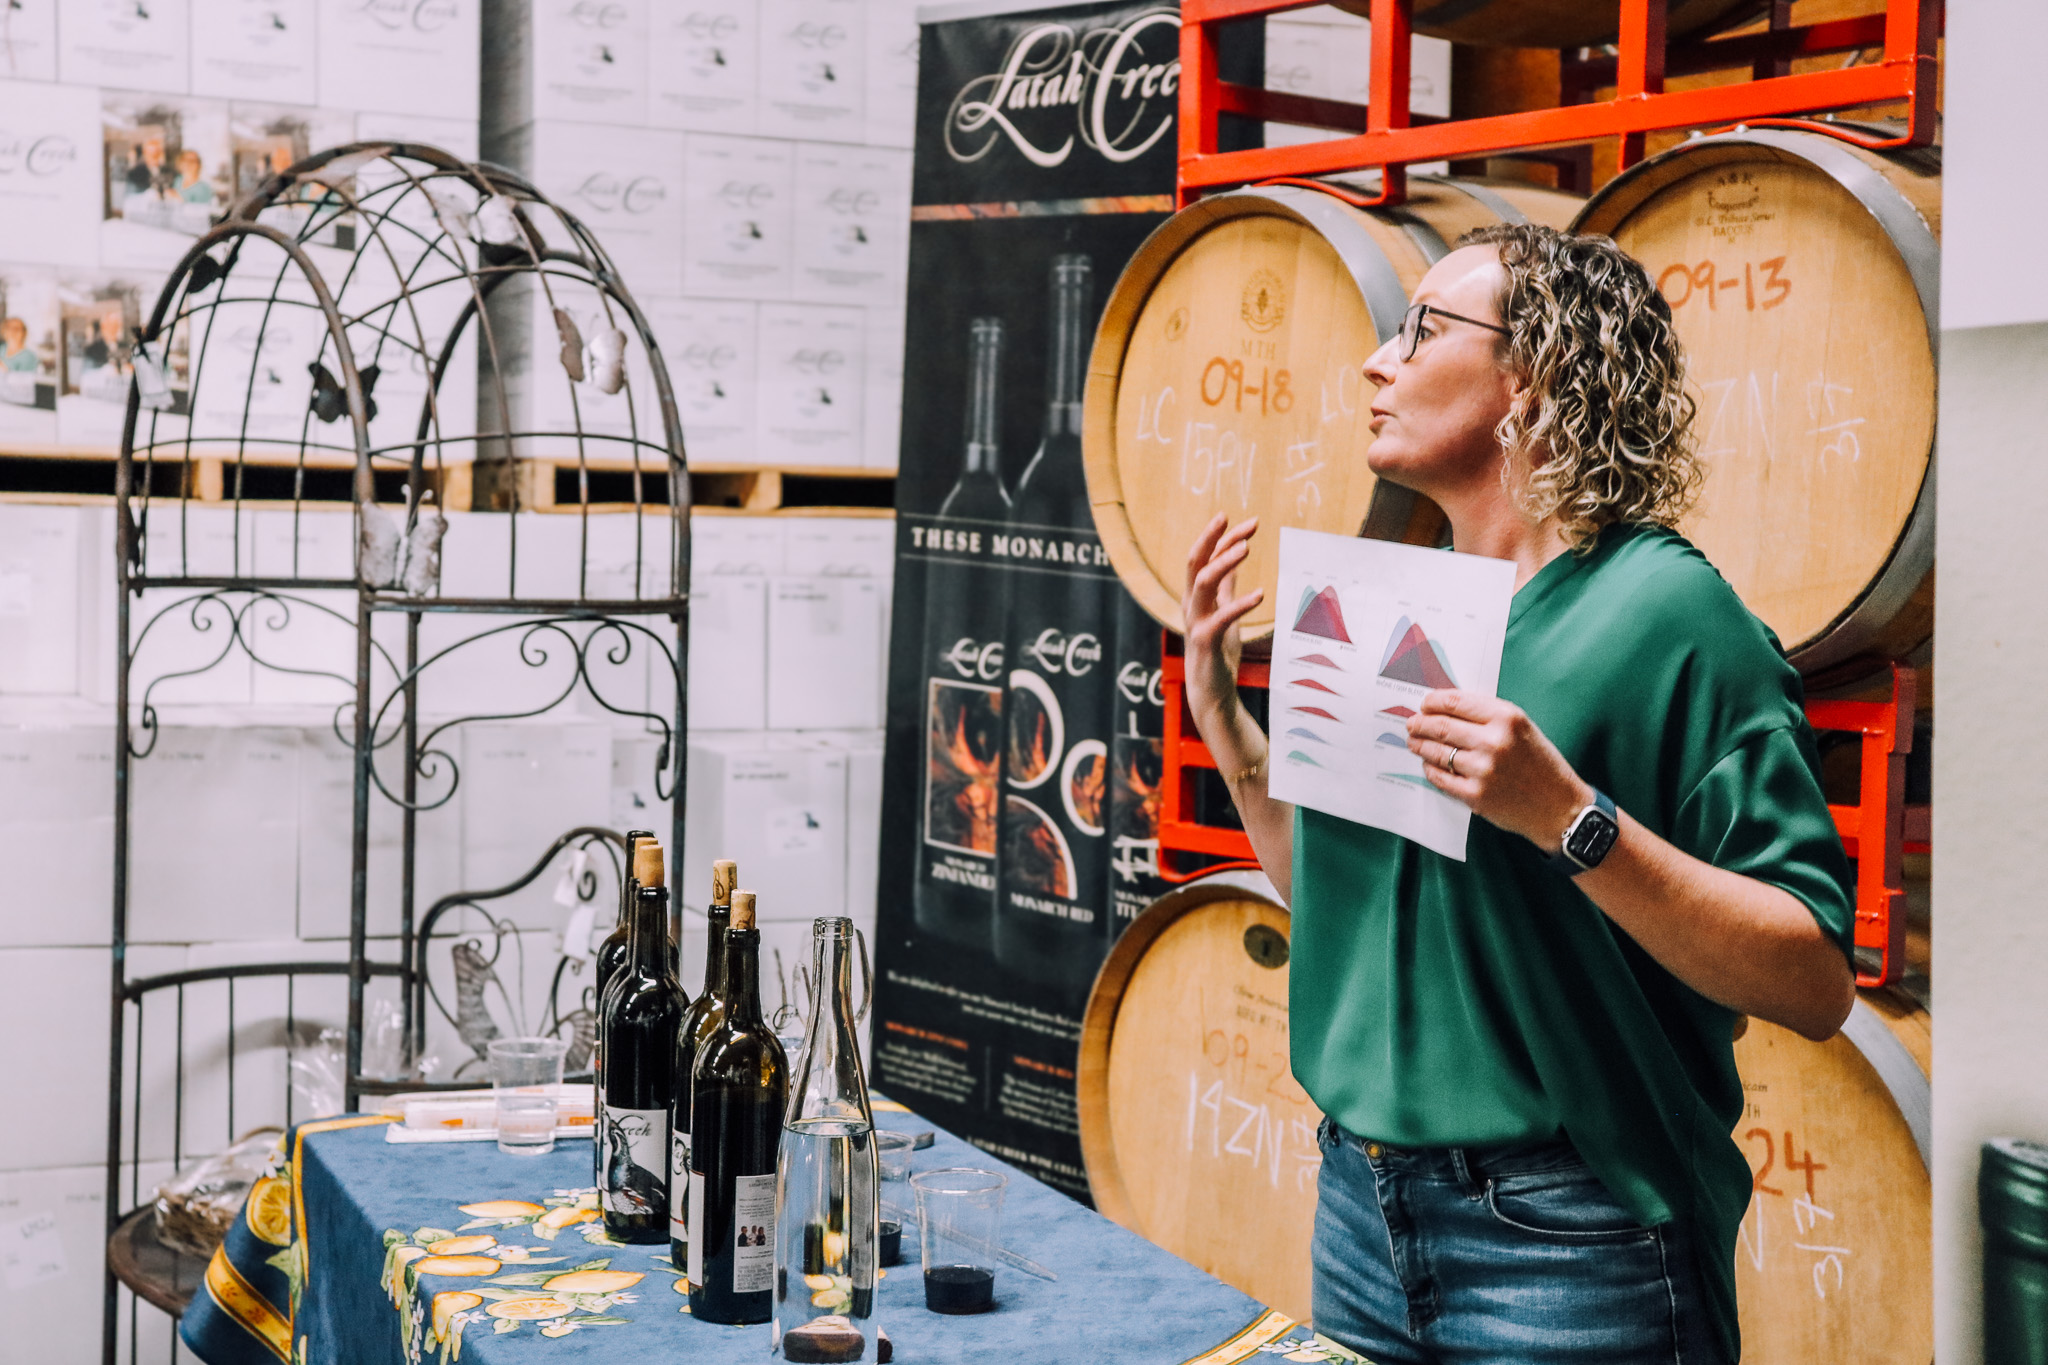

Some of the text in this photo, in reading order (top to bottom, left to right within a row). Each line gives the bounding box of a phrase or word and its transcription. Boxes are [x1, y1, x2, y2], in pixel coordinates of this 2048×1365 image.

[944, 7, 1182, 166] Latah Cree
[1657, 256, 1791, 311] 09-13
[1201, 356, 1295, 416] 09-18
[910, 526, 982, 553] THESE
